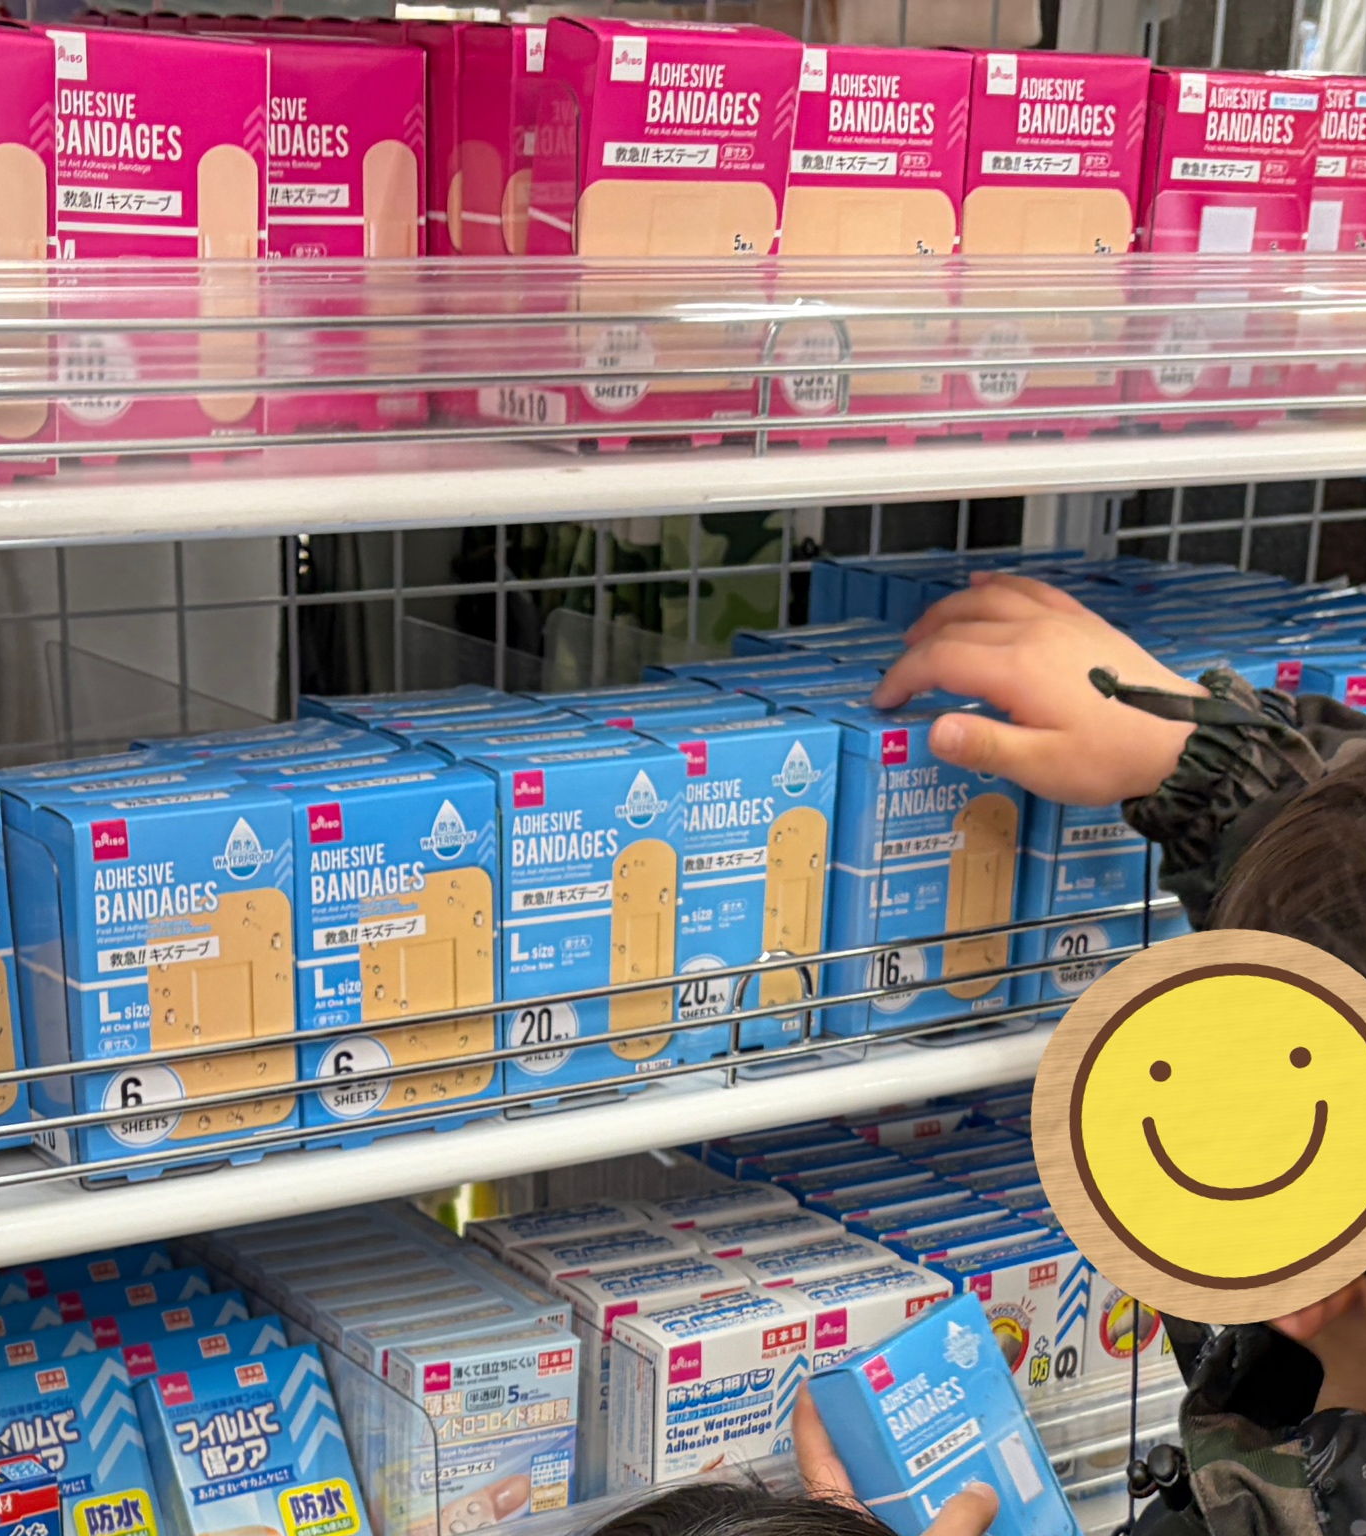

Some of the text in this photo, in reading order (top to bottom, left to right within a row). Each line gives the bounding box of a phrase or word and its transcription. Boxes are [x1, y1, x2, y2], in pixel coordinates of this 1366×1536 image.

[649, 62, 725, 89] ADHESIVE
[831, 73, 900, 100] ADHESIVE
[1019, 75, 1087, 103] ADHESIVE
[645, 90, 761, 127] BANDAGES
[1208, 87, 1267, 111] ADHESIVE
[828, 99, 935, 137] BANDAGES
[1017, 102, 1116, 138] BANDAGES
[1205, 110, 1294, 146] BANDAGES
[878, 766, 939, 790] ADHESIVE
[875, 783, 970, 821] BANDAGES
[512, 809, 583, 836] ADHESIVE
[213, 848, 274, 871] WATERPROOF
[310, 842, 386, 871] ADHESIVE
[512, 828, 620, 867] BANDAGES
[93, 861, 175, 891] ADHESIVE
[310, 861, 426, 904] BANDAGES
[95, 880, 219, 926] BANDAGES
[314, 969, 362, 999] L size
[100, 992, 151, 1022] L size
[333, 1089, 379, 1107] SHEETS
[120, 1116, 169, 1135] SHEETS
[453, 1356, 536, 1379] 薄くて目立ちにくい
[665, 1402, 774, 1441] Clear Waterproof
[886, 1376, 966, 1441] BANDAGES
[175, 1401, 280, 1453] フィルムで
[664, 1418, 773, 1455] Adhesive Bandage
[201, 1437, 269, 1479] 傷ケア
[85, 1496, 144, 1535] 防水
[288, 1487, 348, 1524] 防水
